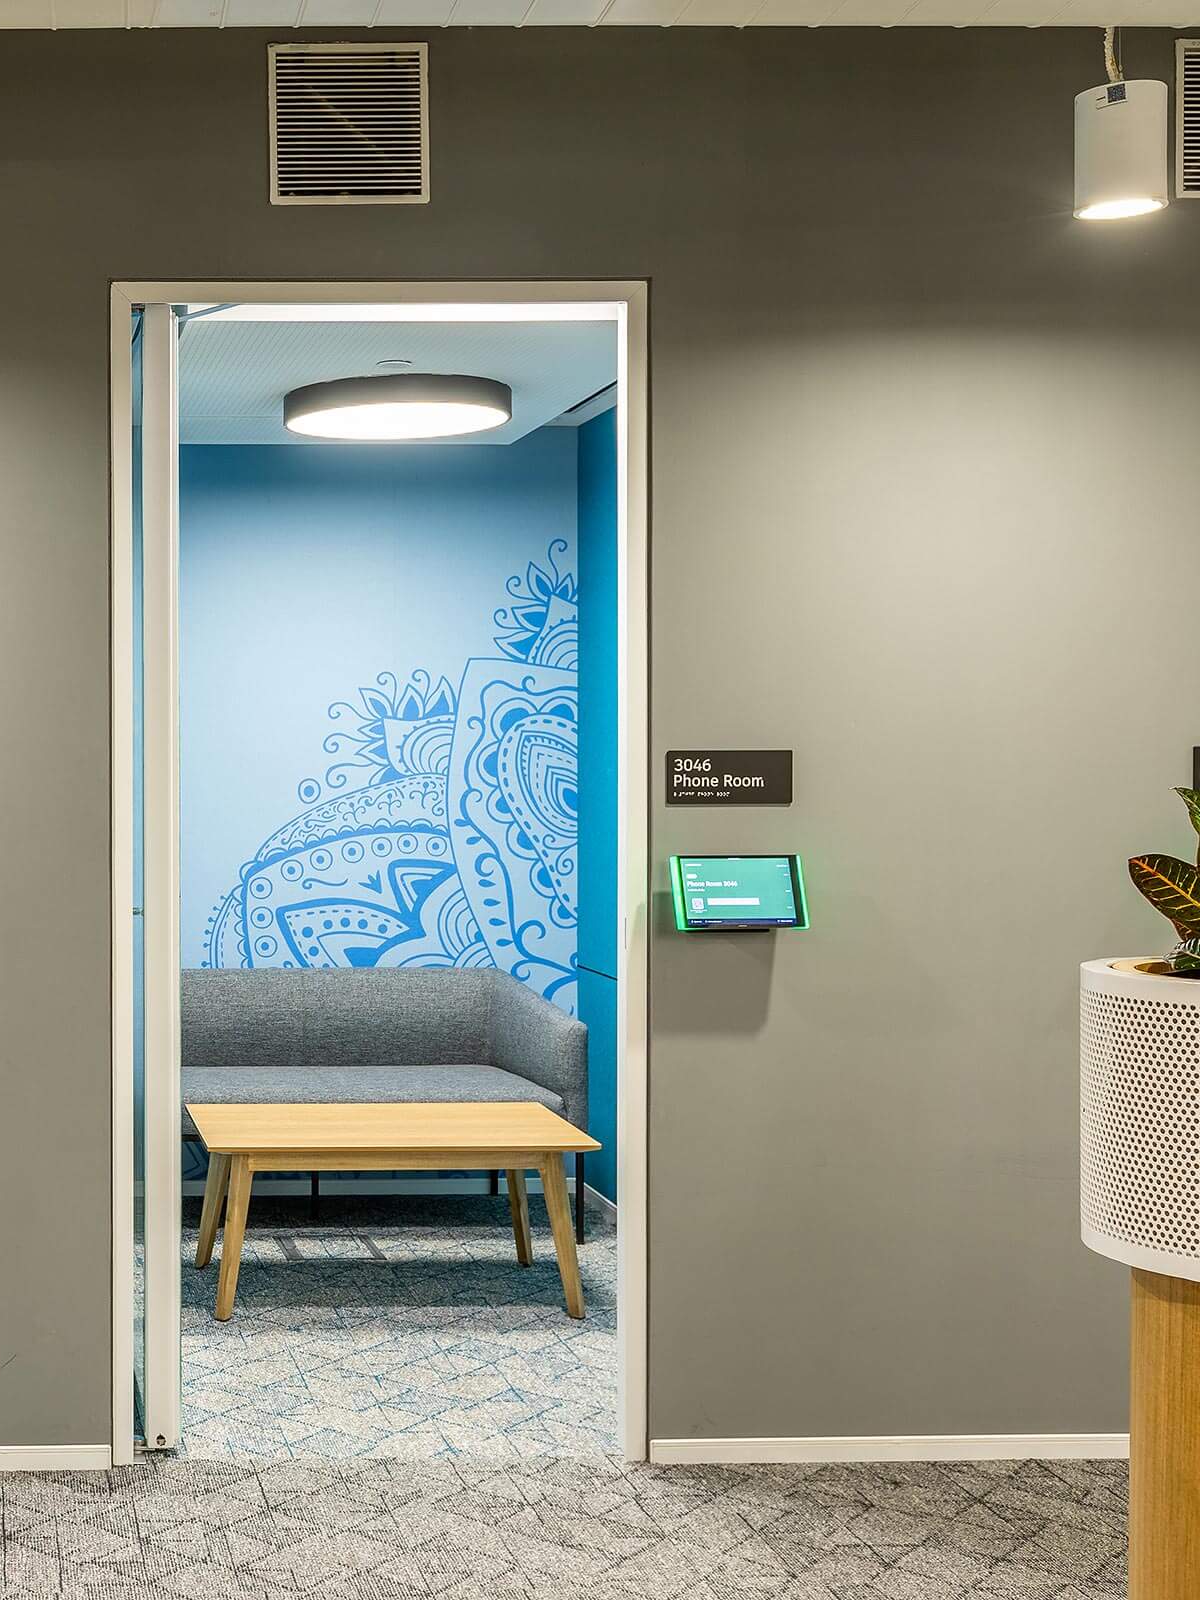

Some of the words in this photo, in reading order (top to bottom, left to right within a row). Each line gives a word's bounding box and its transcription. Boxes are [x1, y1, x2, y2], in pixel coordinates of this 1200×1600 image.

[673, 758, 712, 772] 3046
[673, 774, 719, 787] Phone
[723, 774, 765, 787] Room
